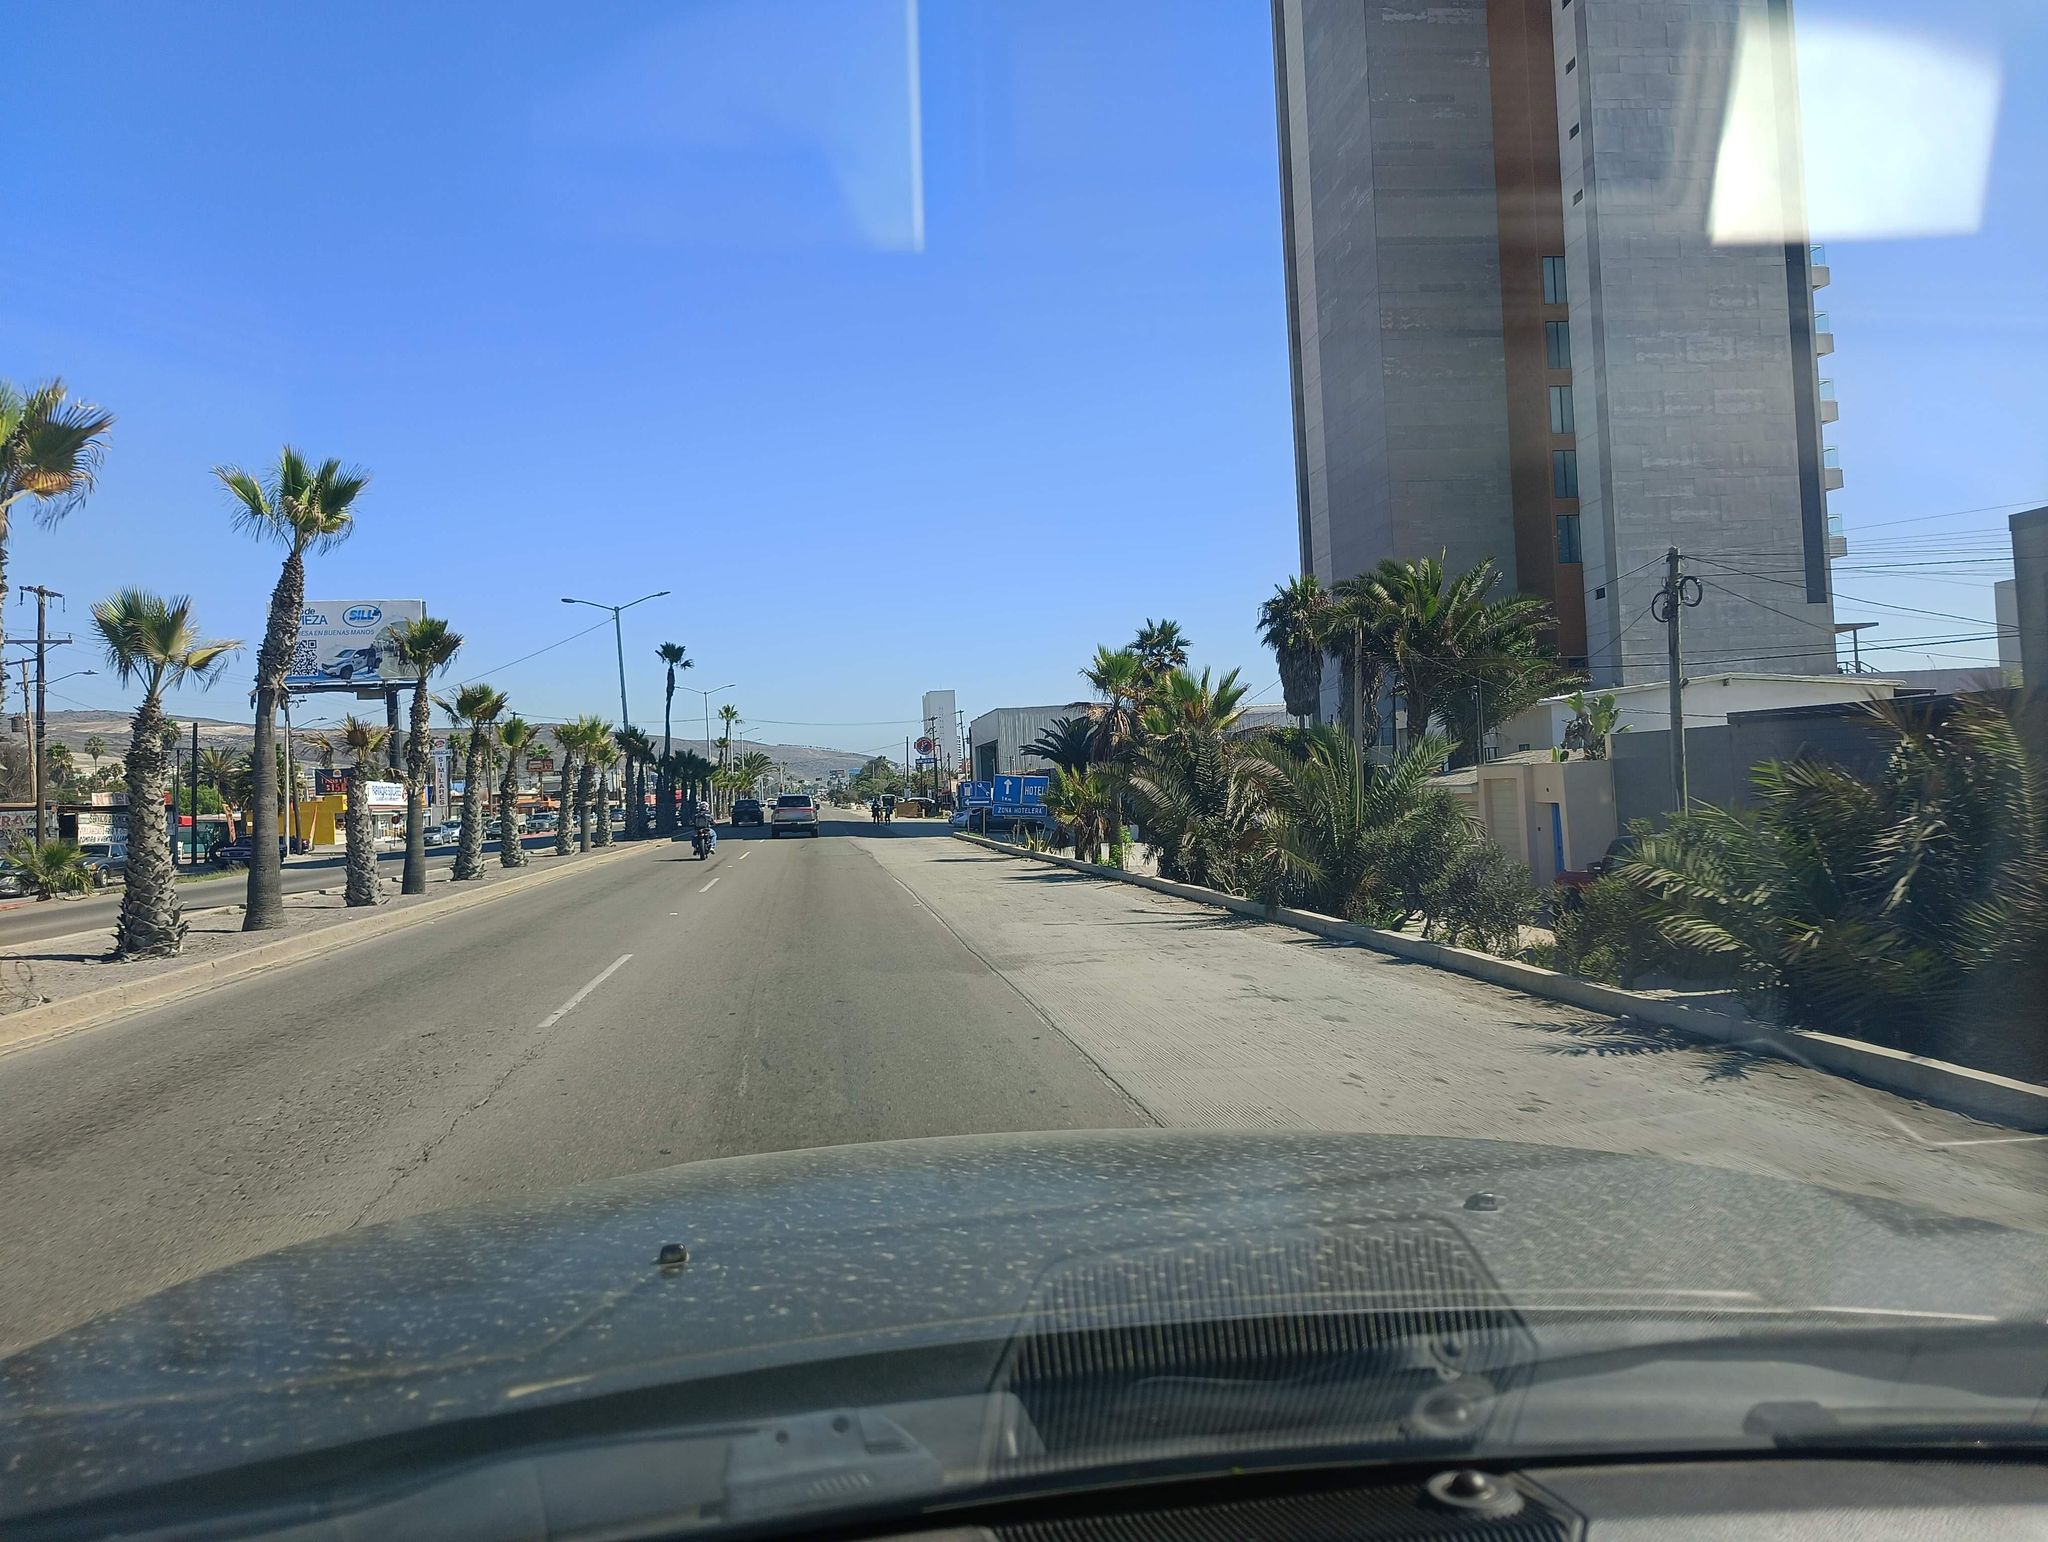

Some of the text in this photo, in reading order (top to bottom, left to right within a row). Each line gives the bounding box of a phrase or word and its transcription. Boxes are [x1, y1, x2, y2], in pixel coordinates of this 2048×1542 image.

[305, 607, 316, 615] de
[349, 609, 374, 621] SILL
[300, 615, 328, 625] IEZA
[0, 815, 24, 826] RA
